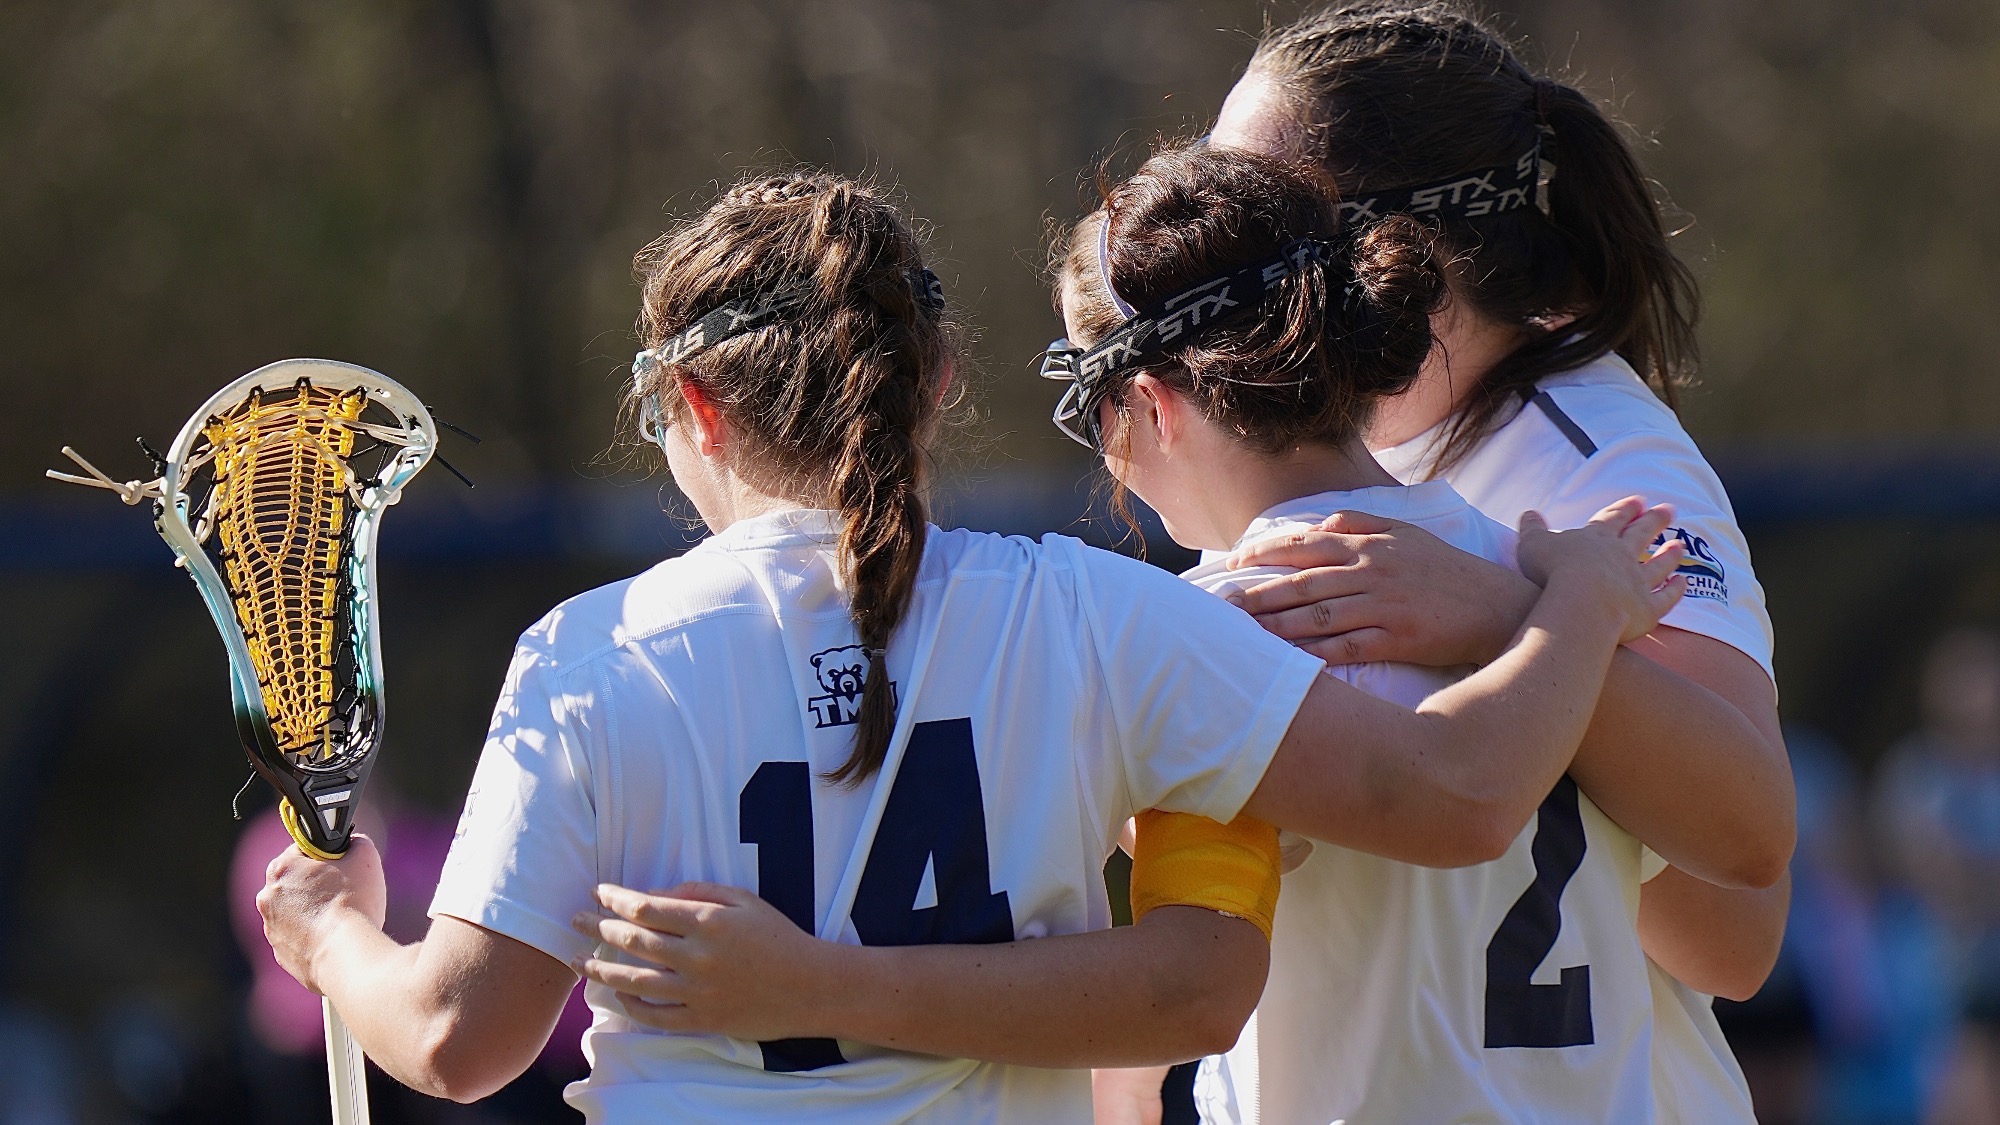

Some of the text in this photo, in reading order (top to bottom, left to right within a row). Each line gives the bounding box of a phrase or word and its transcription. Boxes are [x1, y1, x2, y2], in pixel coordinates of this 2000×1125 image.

[1411, 170, 1497, 213] STX
[1157, 285, 1239, 344] STX
[1080, 335, 1142, 387] STX
[1650, 527, 1715, 563] AC
[808, 681, 898, 729] TM
[739, 717, 1016, 1073] 14
[1483, 771, 1595, 1049] 2
